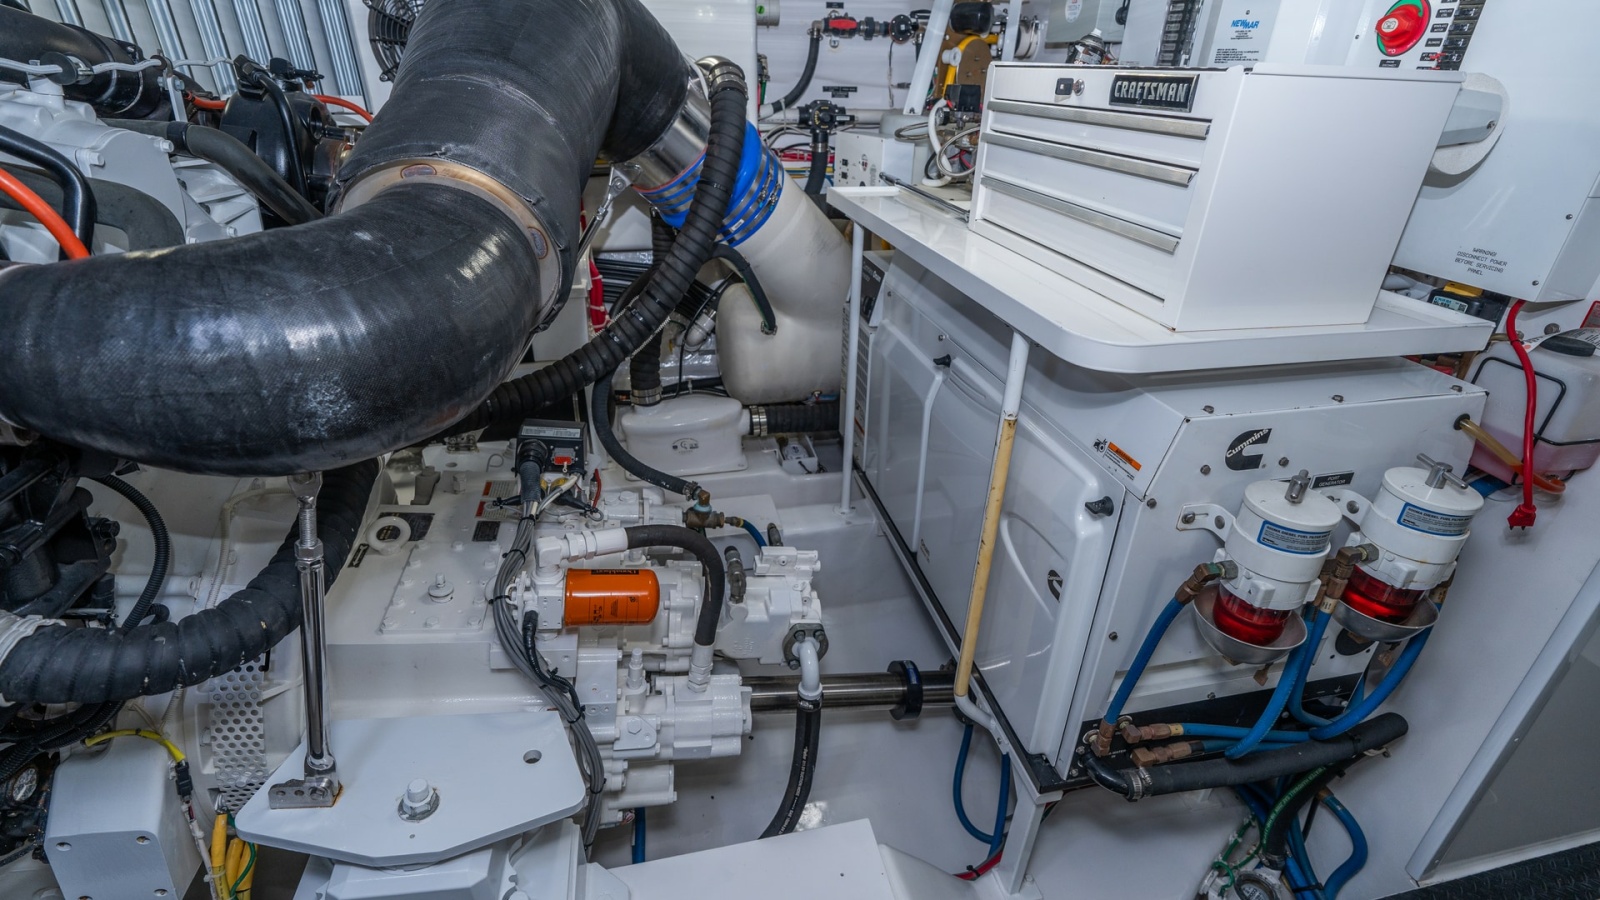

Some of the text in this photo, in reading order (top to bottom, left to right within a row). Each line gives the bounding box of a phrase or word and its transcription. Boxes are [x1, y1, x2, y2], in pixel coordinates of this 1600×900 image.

[1231, 19, 1260, 29] NEWMAR
[1114, 81, 1189, 102] CRAFTSMAN
[1456, 251, 1487, 262] DISCONNECT
[1455, 257, 1504, 273] BEFORE SERVICING
[1226, 428, 1269, 458] Cummins
